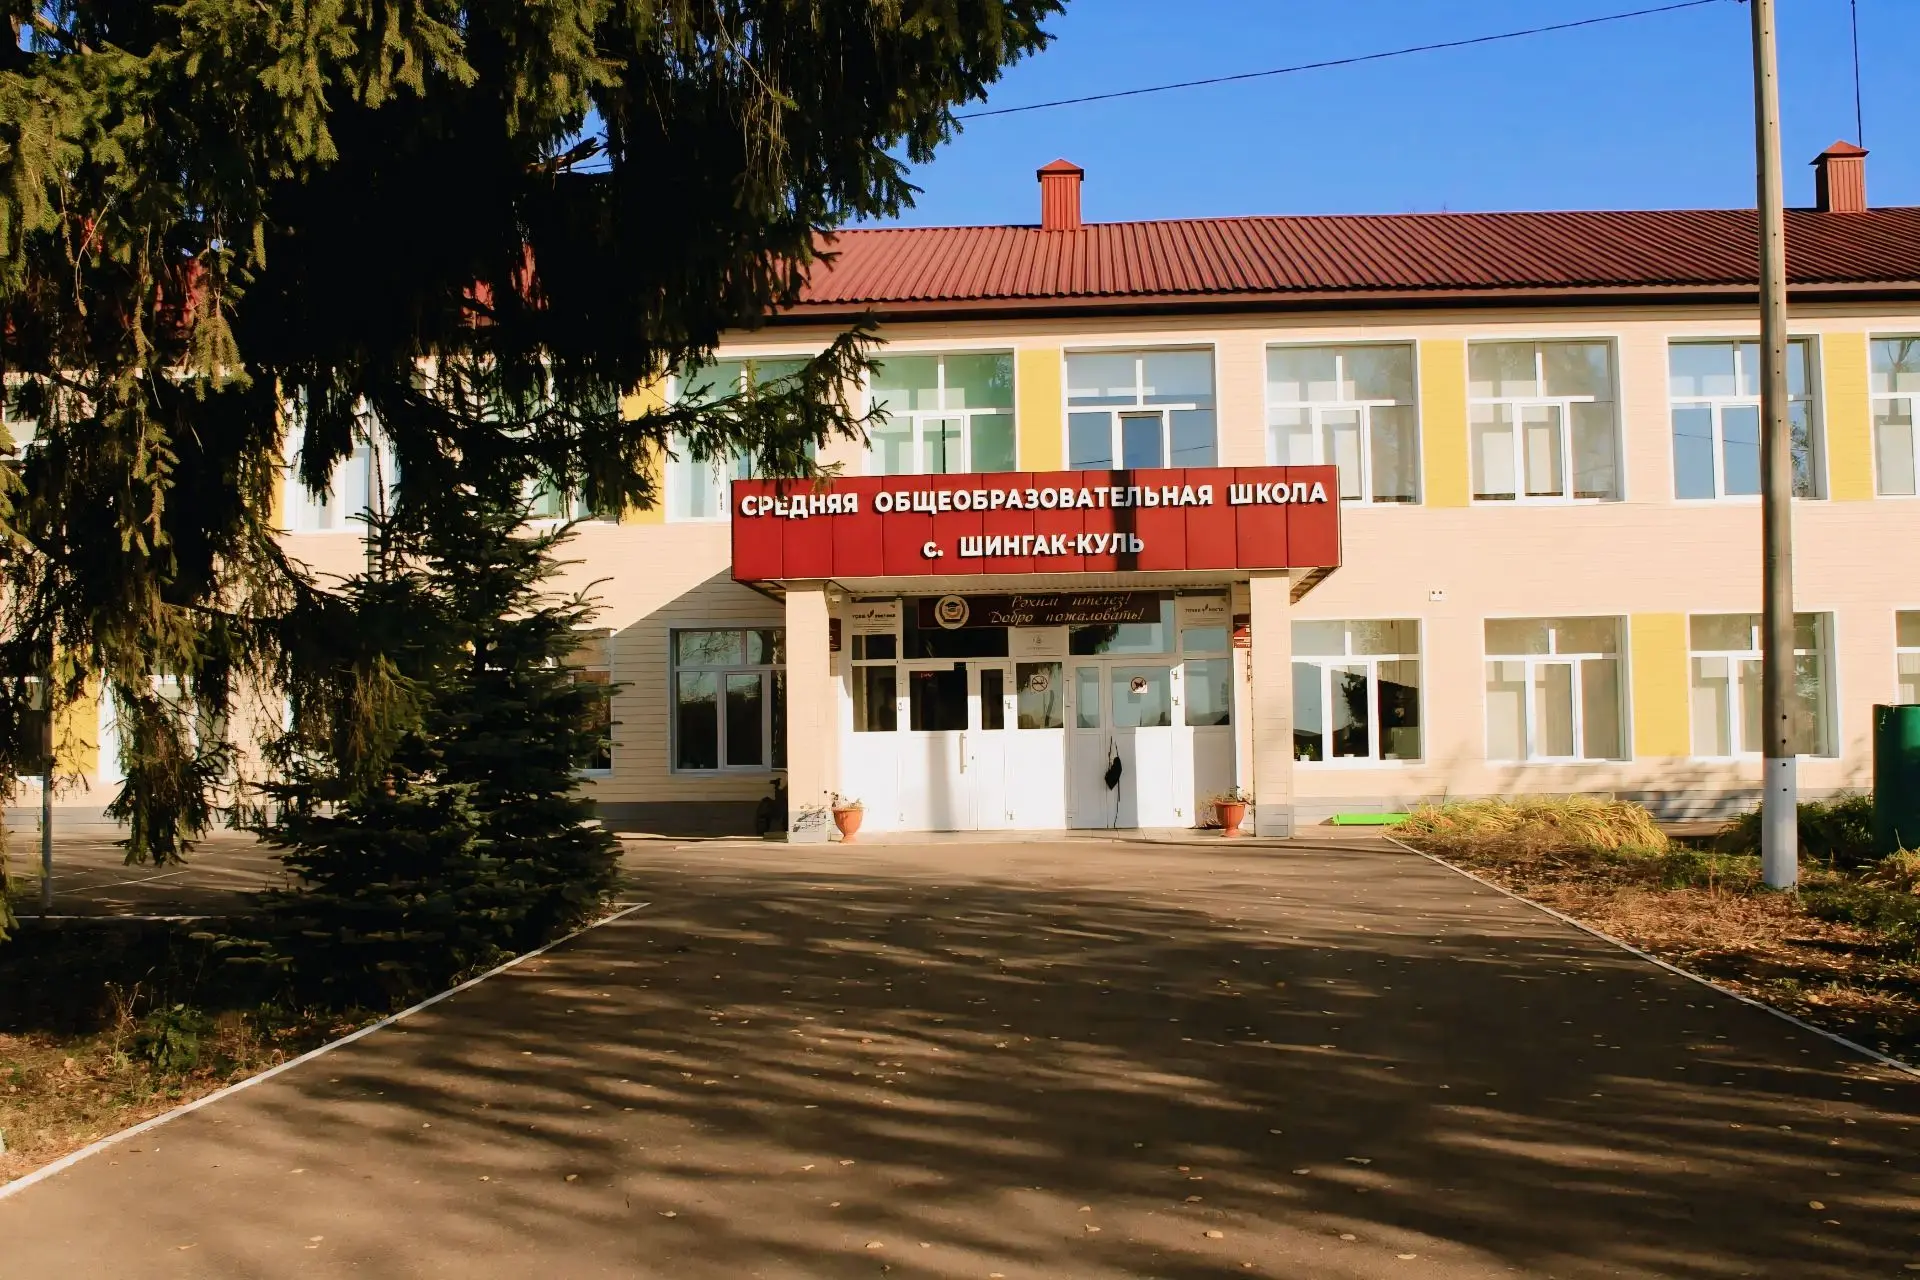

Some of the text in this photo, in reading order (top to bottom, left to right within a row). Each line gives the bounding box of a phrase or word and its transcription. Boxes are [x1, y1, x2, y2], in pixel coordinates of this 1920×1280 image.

[741, 481, 1328, 519] СРЕДНЯЯ ОБЩЕОБРАЗОВАТЕЛЬНАЯ ШКОЛА
[923, 532, 1145, 558] с. ШИНГАК-КУЛЬ
[989, 608, 1145, 626] Добро пожаловать!
